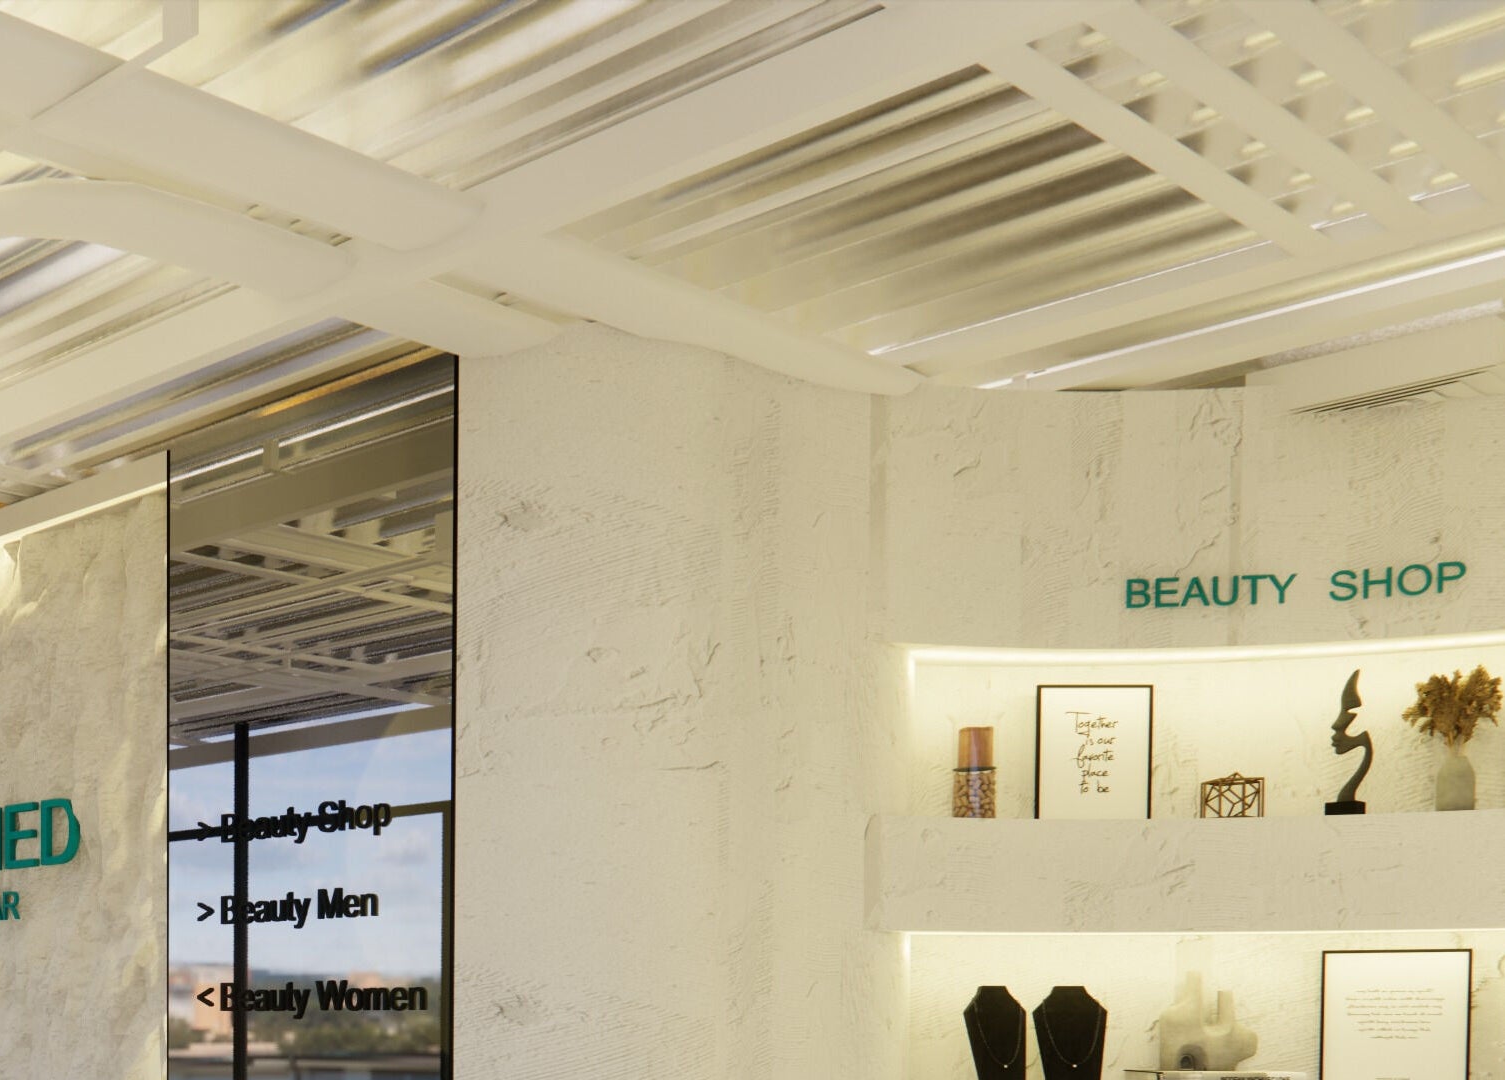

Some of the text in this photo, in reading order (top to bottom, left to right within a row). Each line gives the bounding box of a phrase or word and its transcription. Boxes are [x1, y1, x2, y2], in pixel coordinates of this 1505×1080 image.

[1125, 561, 1467, 609] BEAUTY SHOP
[1065, 711, 1119, 738] Together
[1096, 737, 1117, 745] our
[1070, 744, 1115, 769] favorite
[1081, 763, 1110, 782] place
[1079, 779, 1111, 794] to be
[220, 799, 393, 844] Beauty Shop
[220, 887, 380, 929] Beauty Men
[220, 979, 429, 1020] Beauty Women
